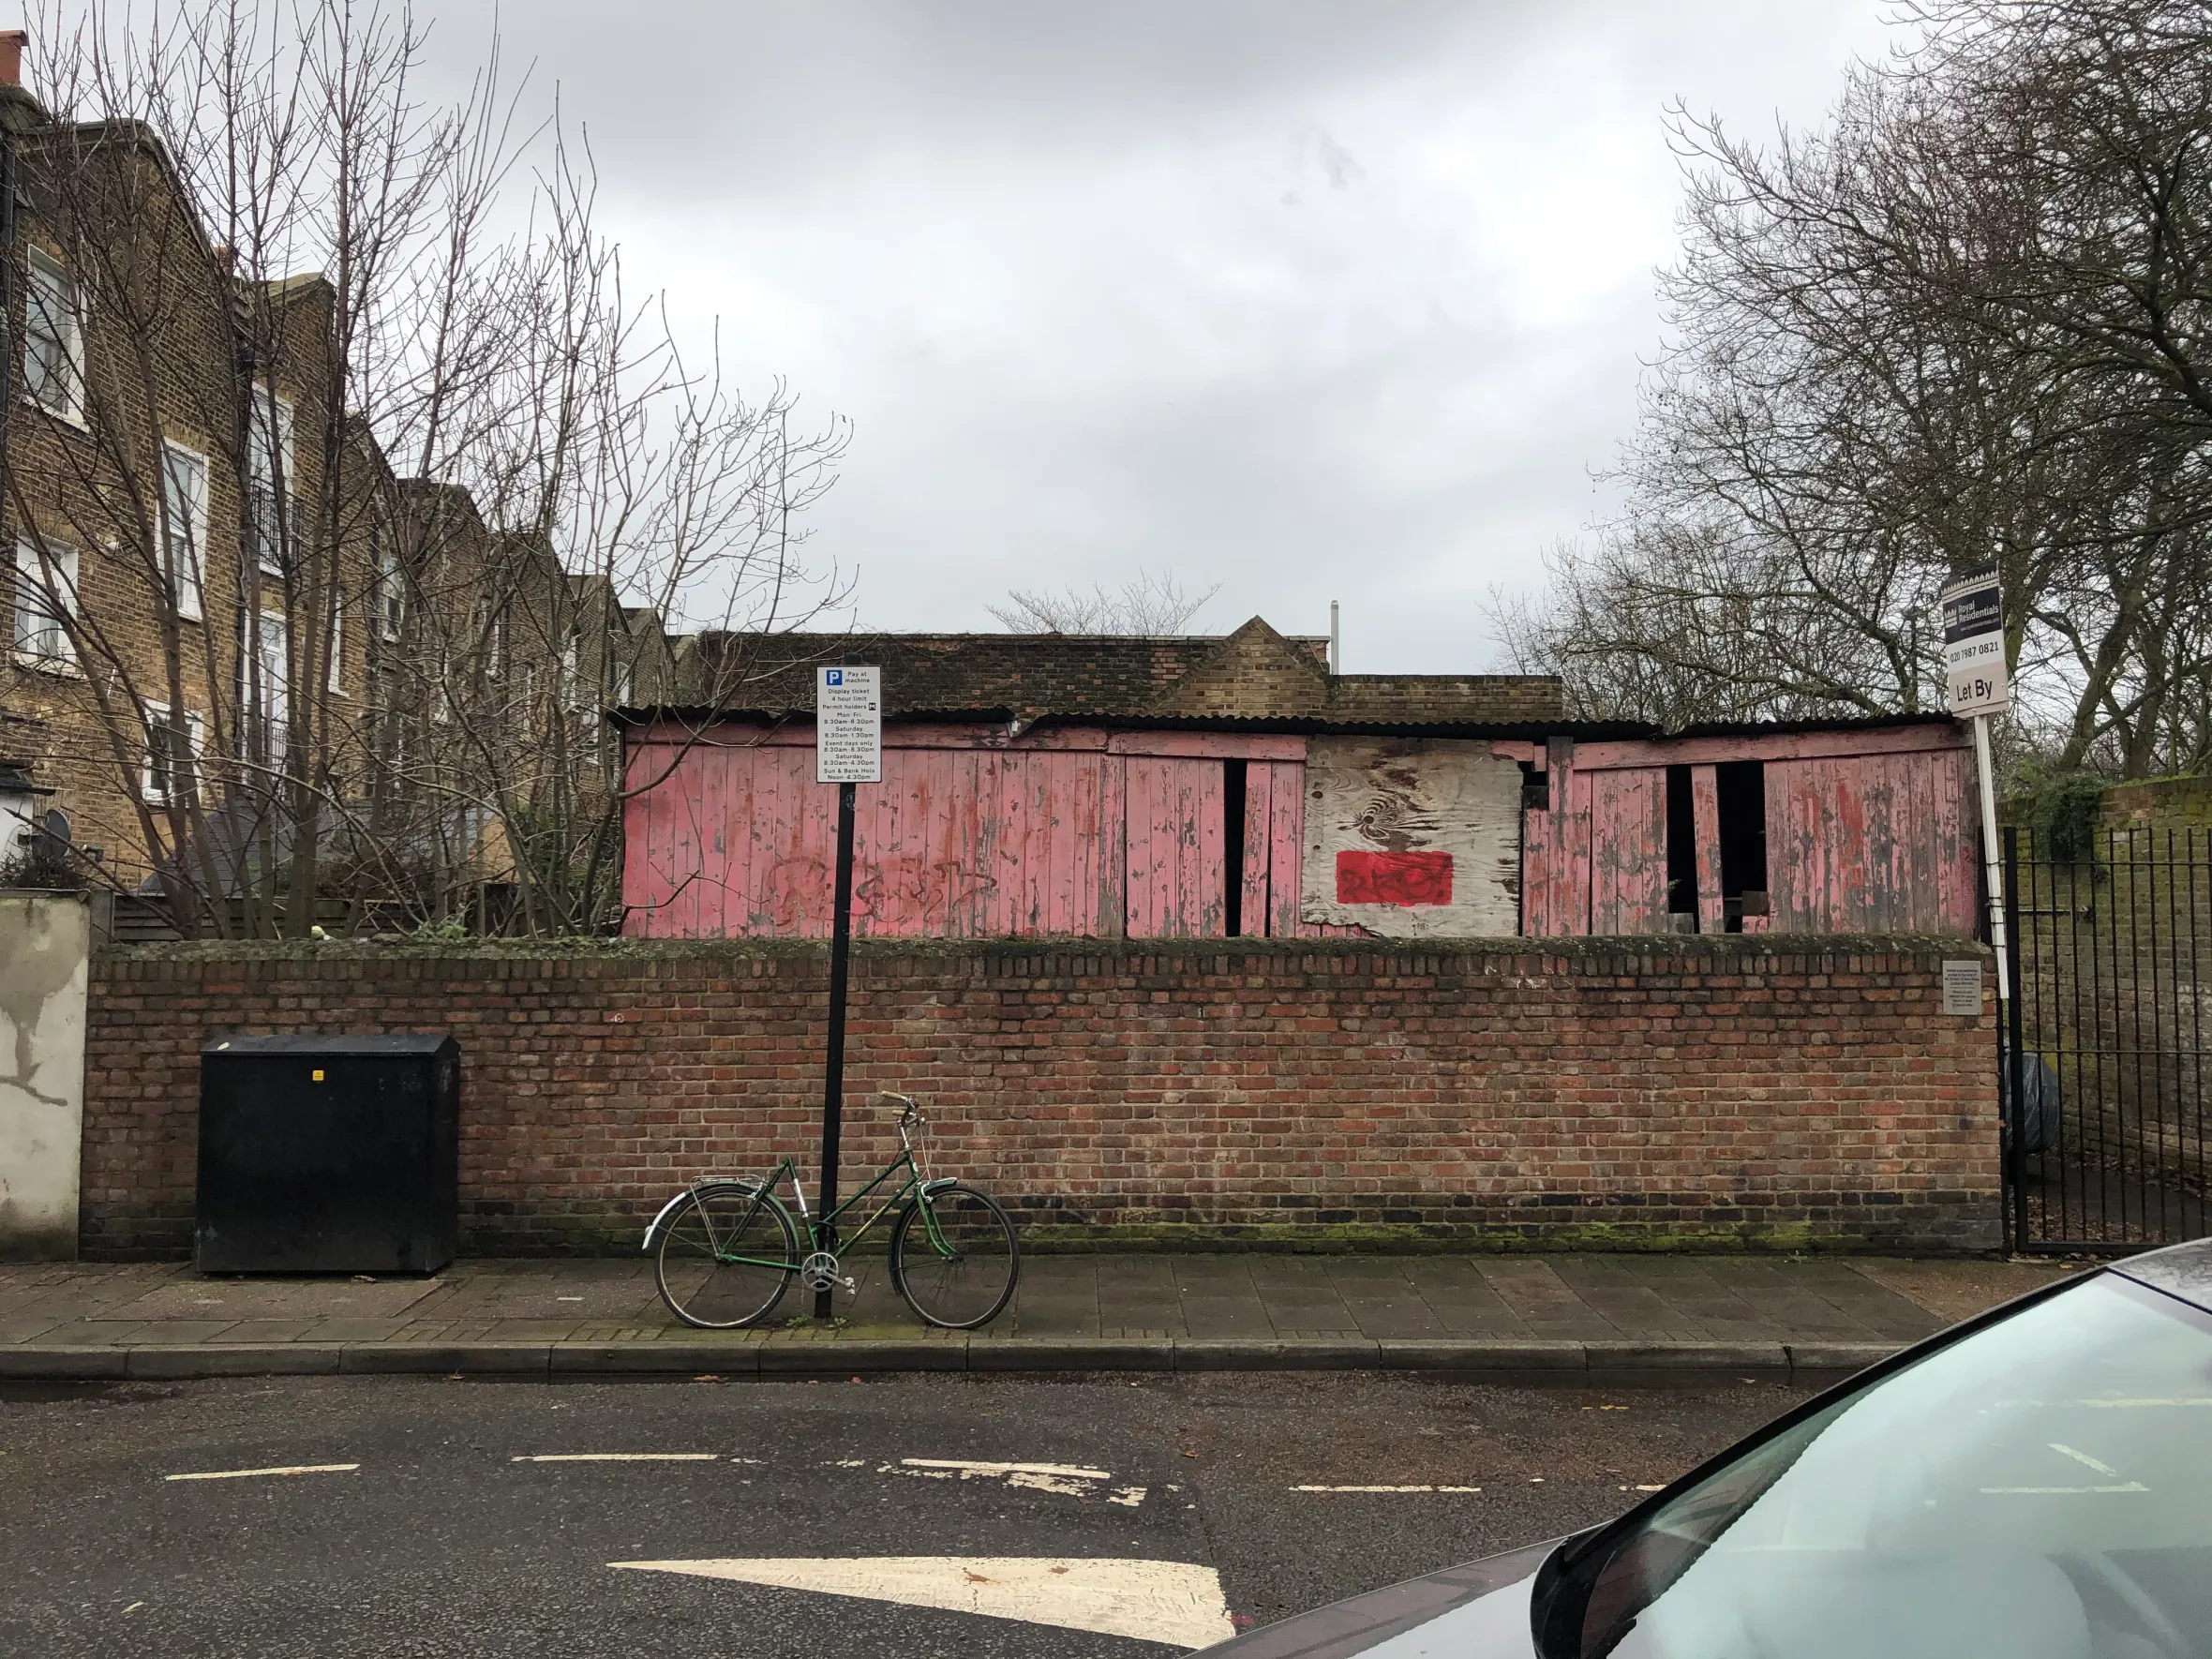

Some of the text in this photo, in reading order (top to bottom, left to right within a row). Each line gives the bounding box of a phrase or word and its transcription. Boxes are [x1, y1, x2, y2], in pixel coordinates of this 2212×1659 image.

[1959, 600, 1975, 613] Royal
[1959, 604, 1998, 623] Residentials
[1950, 641, 1998, 663] 020 7987 0821
[829, 672, 839, 683] P
[1957, 679, 1992, 702] Let By
